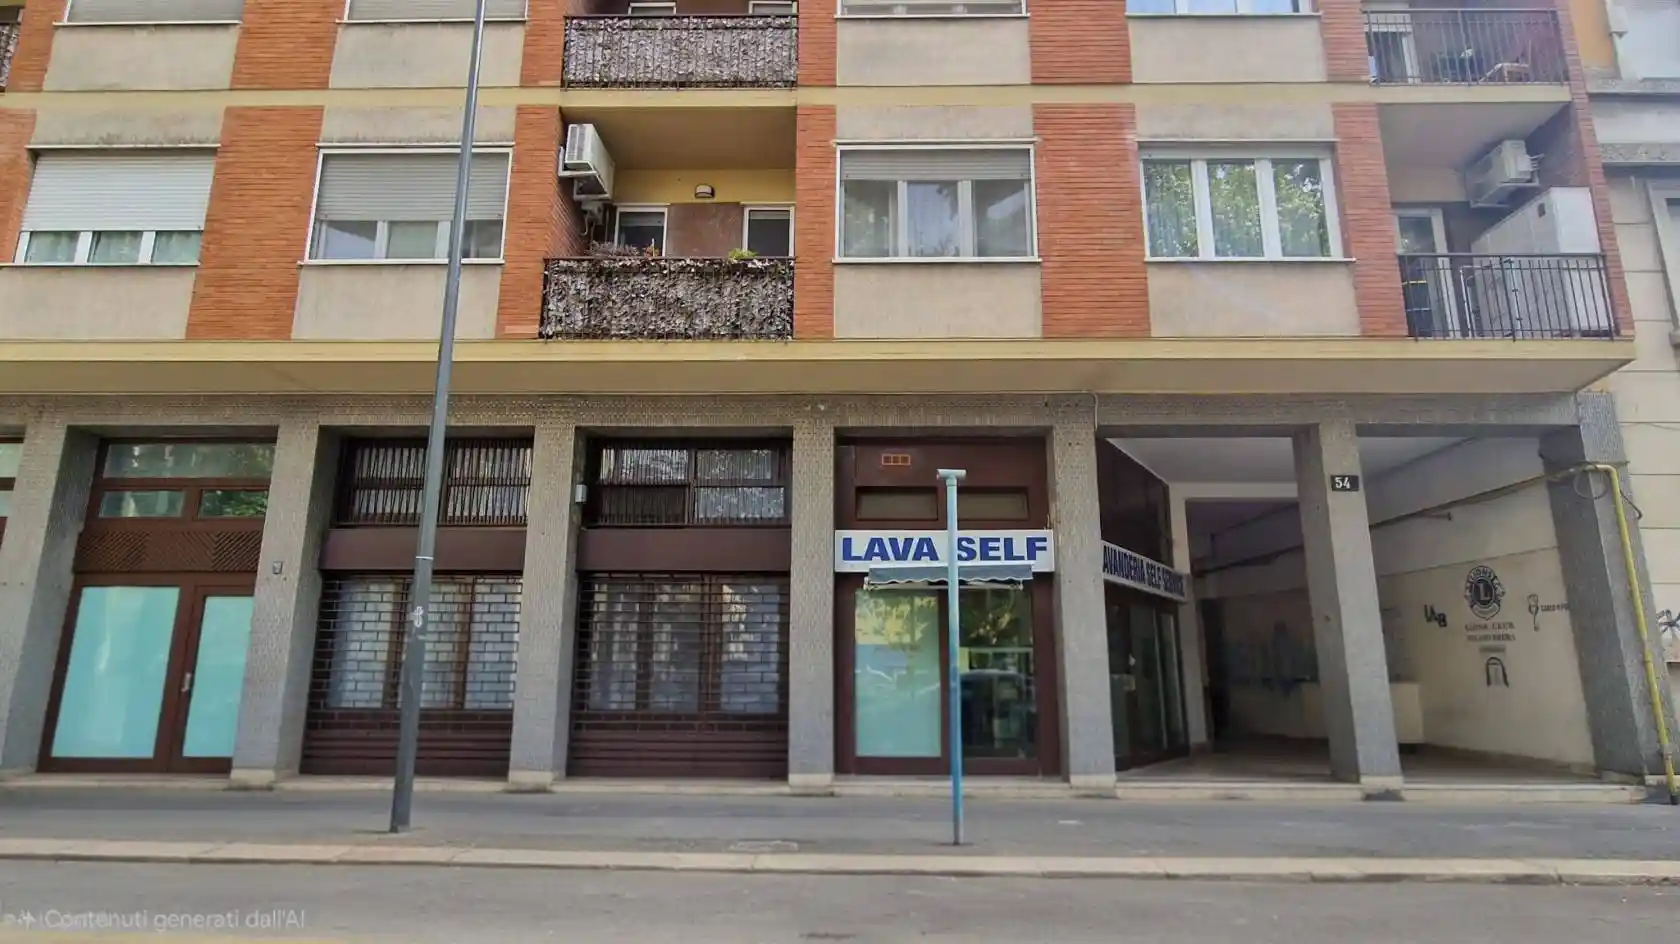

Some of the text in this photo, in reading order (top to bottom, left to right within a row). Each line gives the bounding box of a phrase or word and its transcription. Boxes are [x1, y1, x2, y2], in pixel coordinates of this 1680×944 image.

[1335, 476, 1350, 489] 54
[842, 536, 1048, 562] LAVA SELF
[1102, 545, 1146, 585] AVANDERIA
